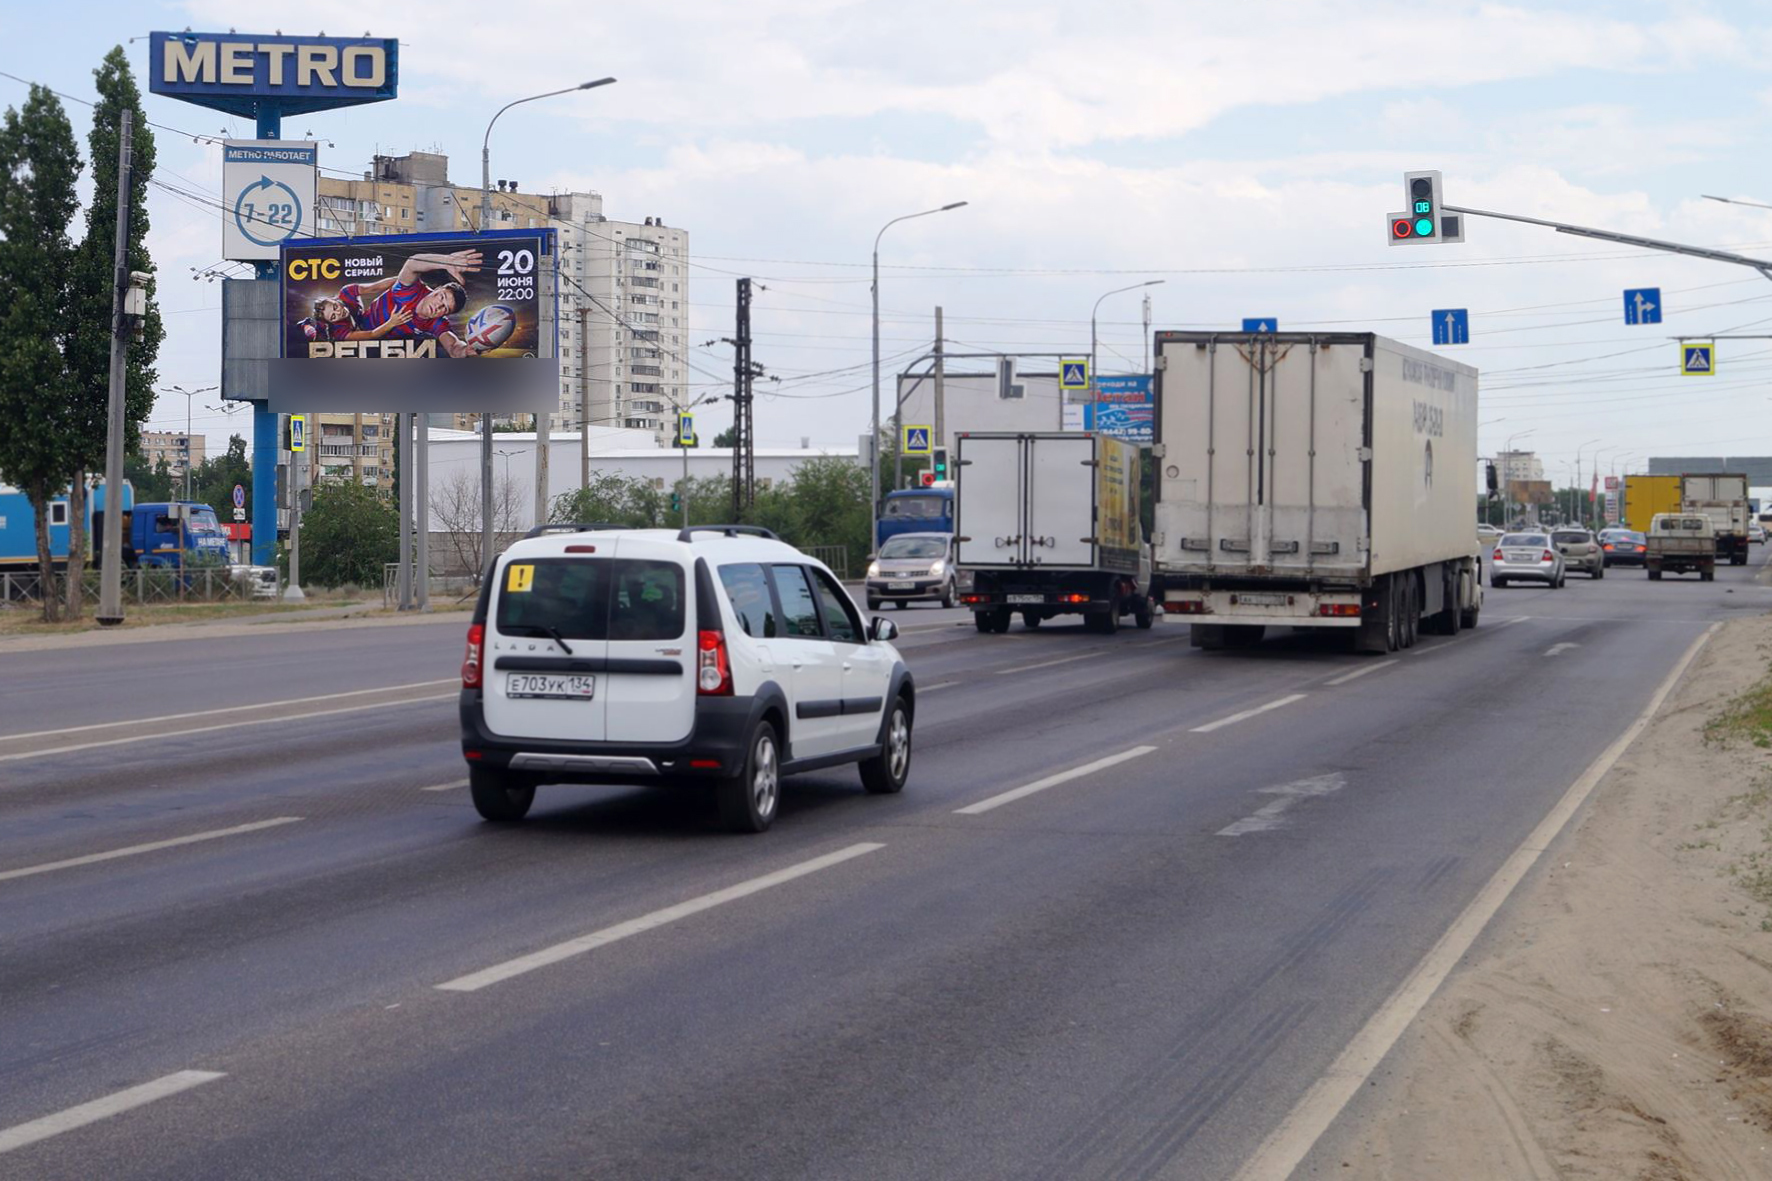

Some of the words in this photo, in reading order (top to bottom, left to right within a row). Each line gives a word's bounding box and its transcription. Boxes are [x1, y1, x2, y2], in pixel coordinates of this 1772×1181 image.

[163, 40, 386, 87] METRO
[344, 255, 383, 267] НОВЫЙ
[497, 249, 534, 275] 20
[288, 257, 341, 281] СТС
[344, 267, 383, 277] СЕРИАЛ
[497, 276, 533, 288] ИЮНЯ
[497, 288, 534, 301] 22:00
[494, 642, 554, 652] LADA
[569, 677, 591, 690] 134
